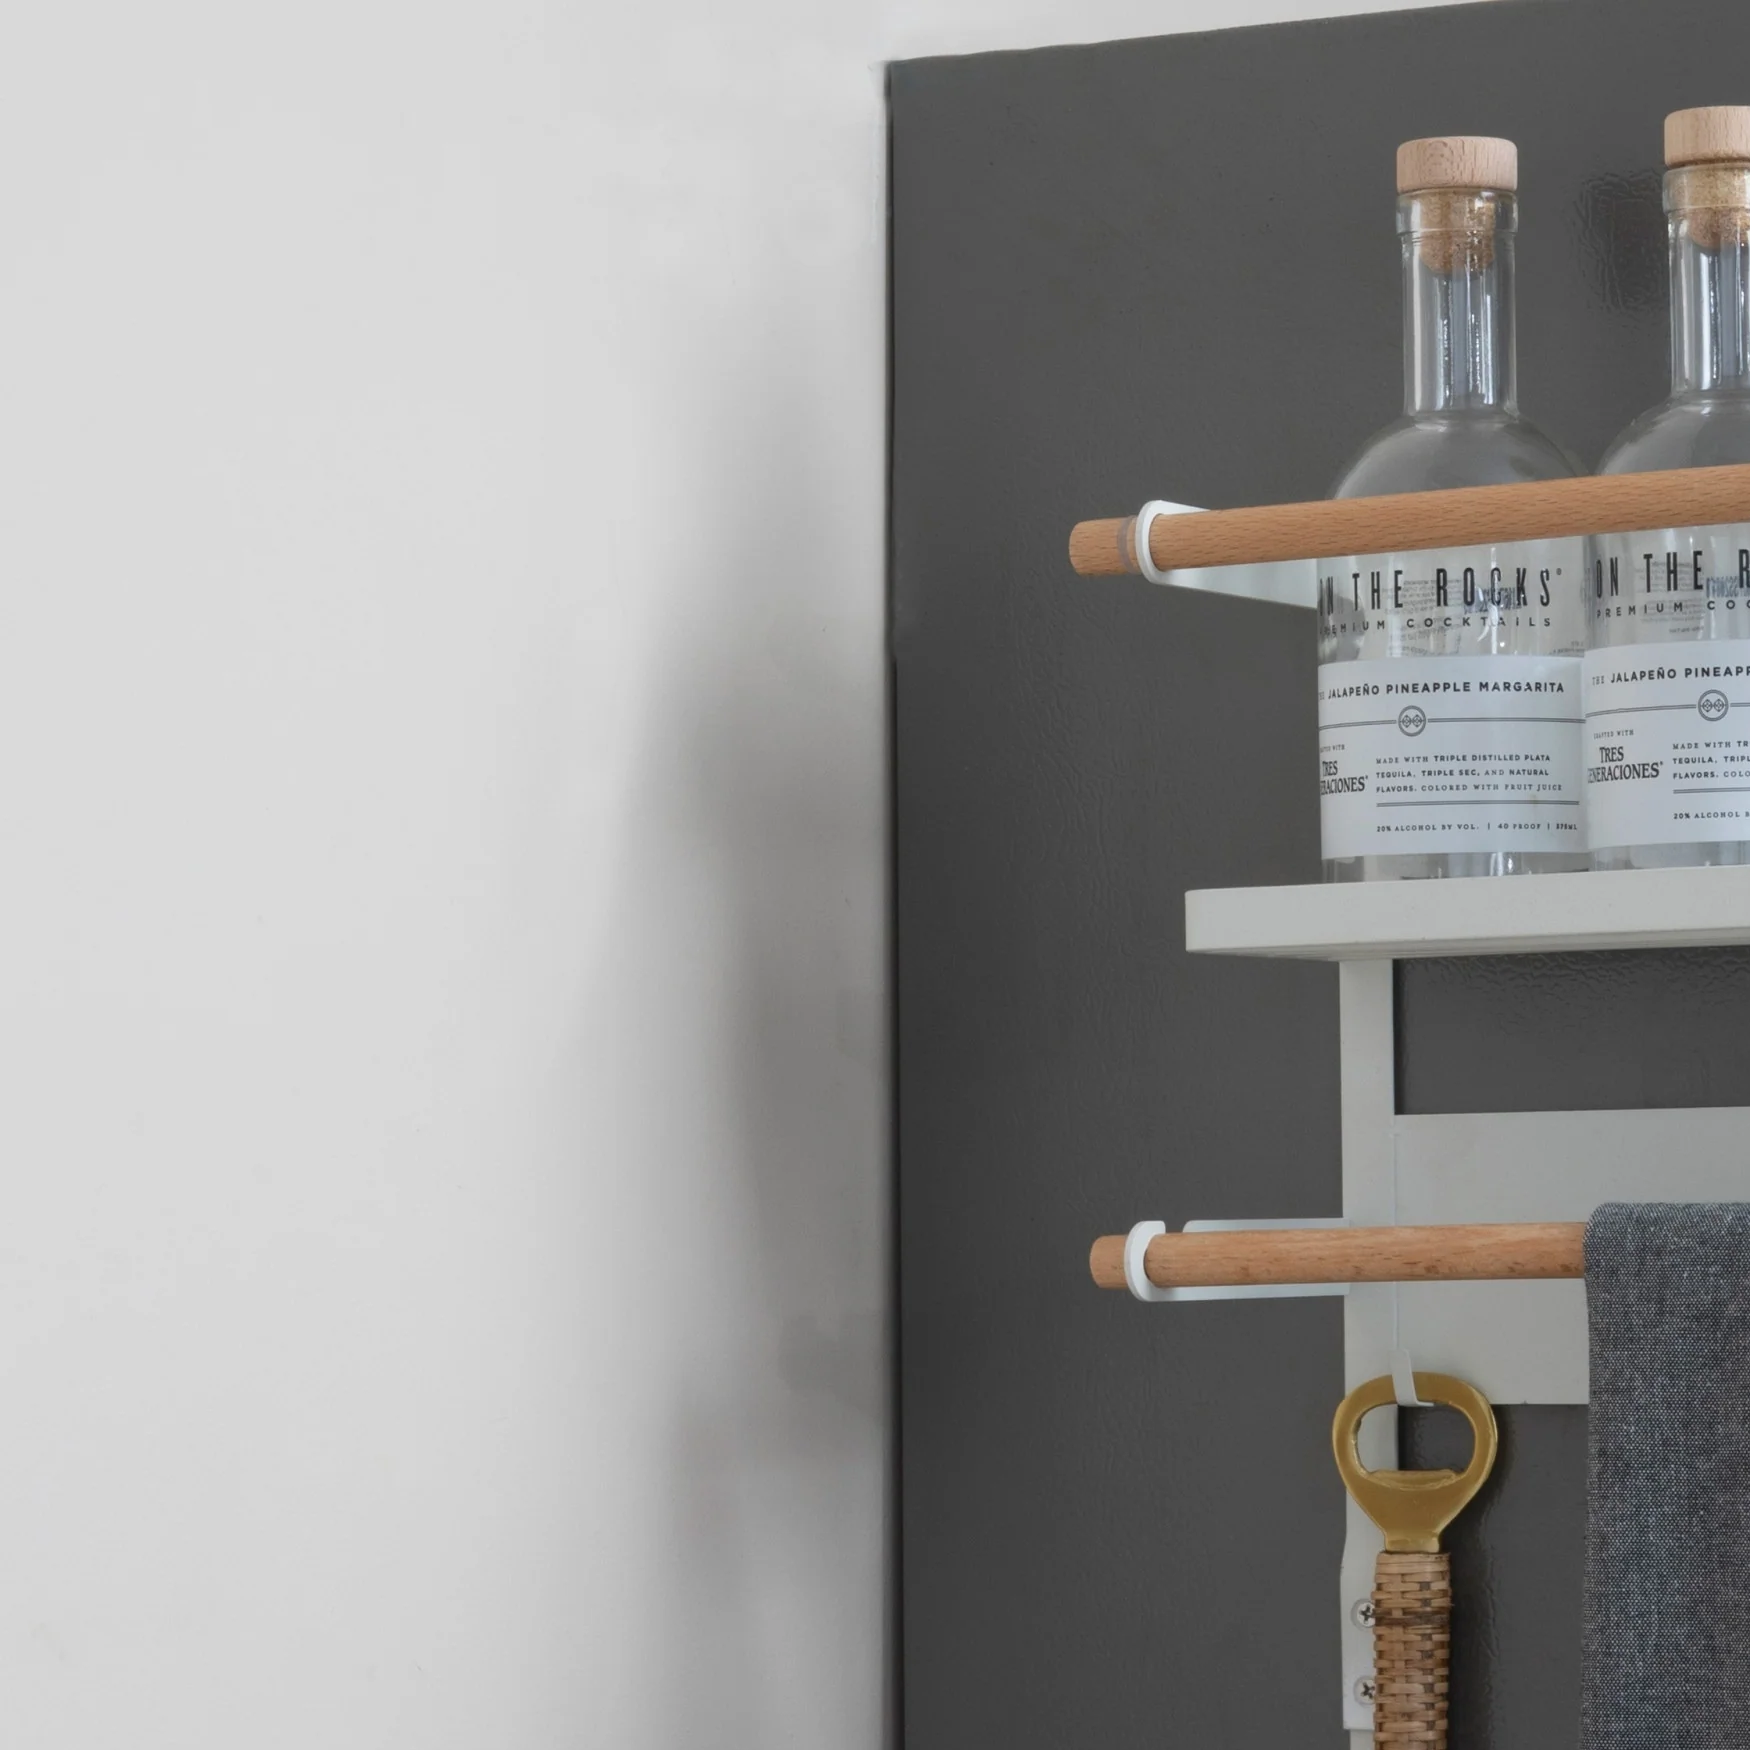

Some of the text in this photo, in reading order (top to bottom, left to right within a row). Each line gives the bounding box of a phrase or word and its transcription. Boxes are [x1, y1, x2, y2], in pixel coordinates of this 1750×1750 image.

[1643, 551, 1704, 593] THE
[1352, 570, 1403, 611] THE
[1597, 602, 1684, 618] PREMIUM
[1406, 617, 1551, 628] COCKTAILS
[1610, 667, 1677, 683] JALAPEÑO
[1328, 683, 1380, 699] JALAPEÑO
[1386, 681, 1472, 694] PINEAPPLE
[1479, 681, 1565, 693] MARGARITA
[1673, 742, 1699, 750] MADE
[1704, 741, 1731, 749] WITH
[1376, 757, 1400, 765] MADE
[1472, 754, 1520, 762] DISTILLED
[1524, 754, 1551, 762] PLATA
[1599, 746, 1624, 764] TRES
[1421, 769, 1455, 777] TRIPLE
[1587, 762, 1661, 783] ENERACIONES
[1537, 784, 1563, 792] JUICE
[1673, 812, 1691, 820] 20%
[1694, 811, 1741, 819] ALCOHOL
[1395, 824, 1437, 832] ALCOHOL
[1441, 823, 1453, 831] BY
